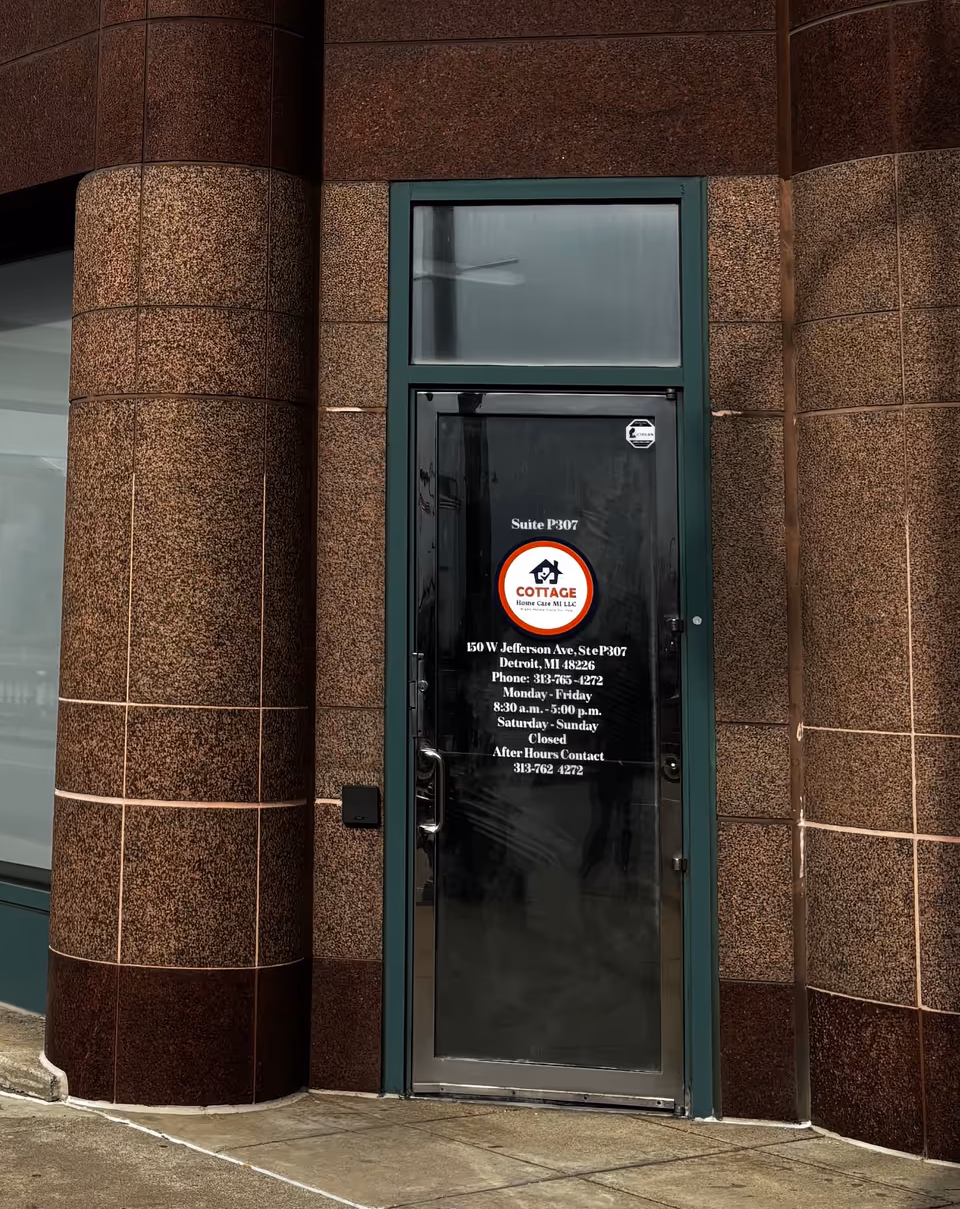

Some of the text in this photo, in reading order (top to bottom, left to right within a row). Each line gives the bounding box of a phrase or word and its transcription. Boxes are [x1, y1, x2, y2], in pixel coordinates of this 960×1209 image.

[511, 518, 579, 531] Suite P307
[516, 586, 577, 598] COTTAGE
[466, 641, 484, 652] 150
[486, 642, 498, 653] W
[500, 642, 551, 654] Jefferson
[553, 644, 578, 657] Ave,
[499, 656, 596, 671] Detroit, MI 48226
[491, 671, 530, 684] Phone:
[503, 686, 548, 701] Monday
[555, 688, 593, 703] Friday
[493, 701, 518, 713] 8:30
[519, 704, 543, 714] a.m.
[550, 704, 576, 715] 5:00
[577, 707, 602, 718] p.m.
[497, 716, 549, 731] Saturday
[556, 718, 599, 733] Sunday
[528, 732, 567, 745] Closed
[492, 746, 605, 762] After Hours Contact
[513, 762, 584, 776] 313-762 4272
